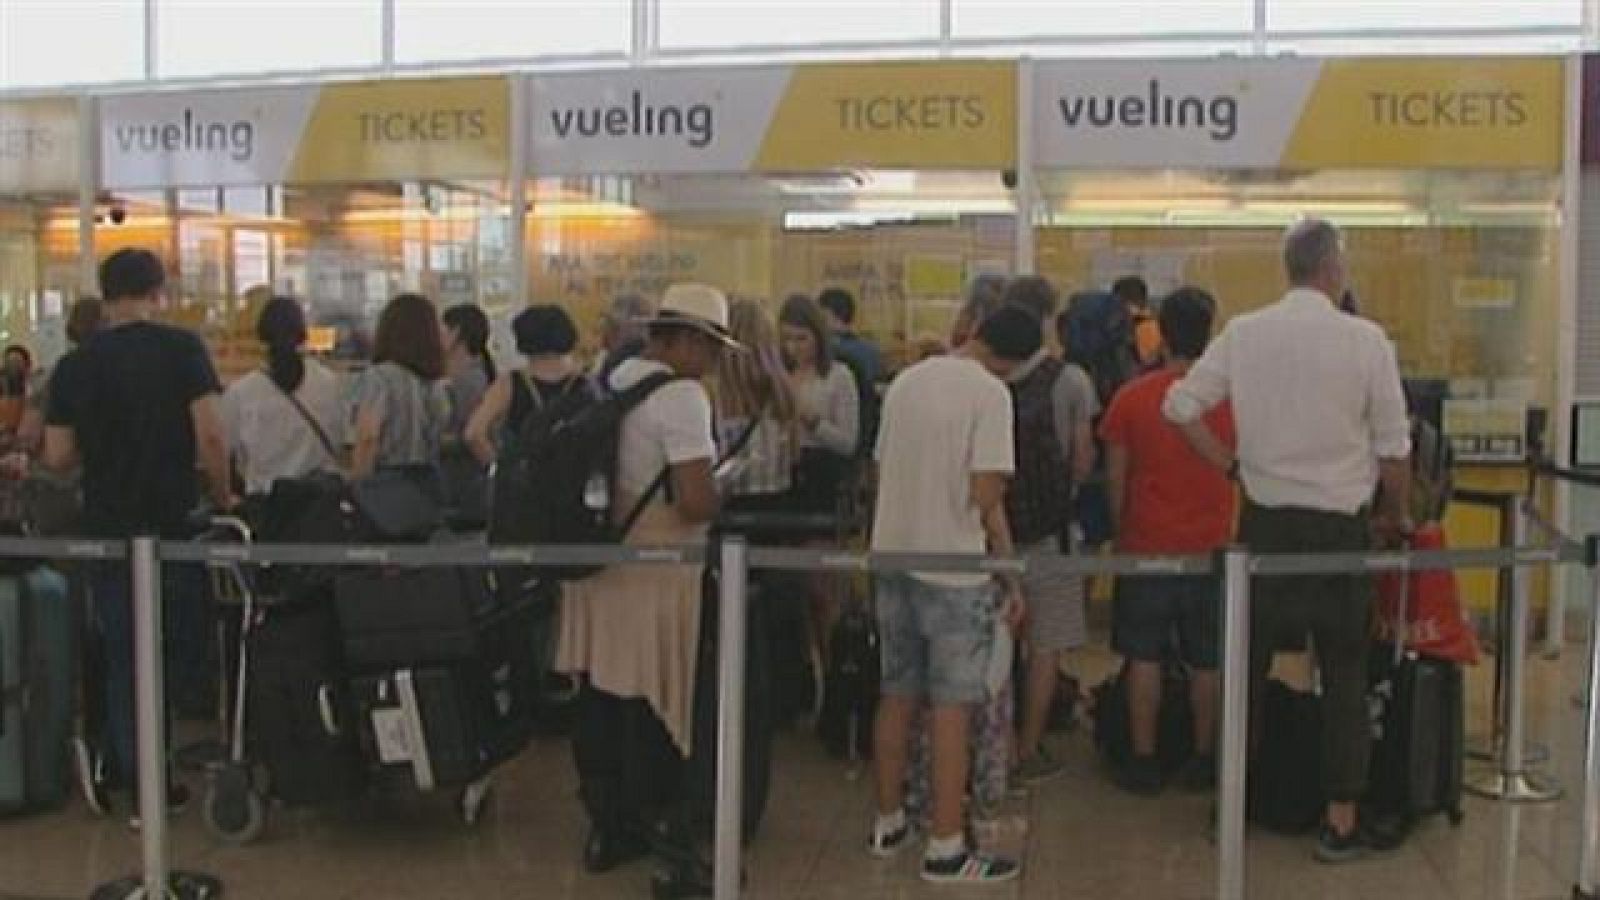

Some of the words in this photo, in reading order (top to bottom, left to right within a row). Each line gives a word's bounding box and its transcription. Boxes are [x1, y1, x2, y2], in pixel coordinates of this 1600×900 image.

[115, 108, 254, 161] vueling
[357, 108, 486, 143] TICKETS
[551, 89, 712, 148] vueling
[836, 95, 985, 130] TICKETS
[1058, 79, 1238, 141] vueling
[1369, 91, 1527, 127] TICKETS
